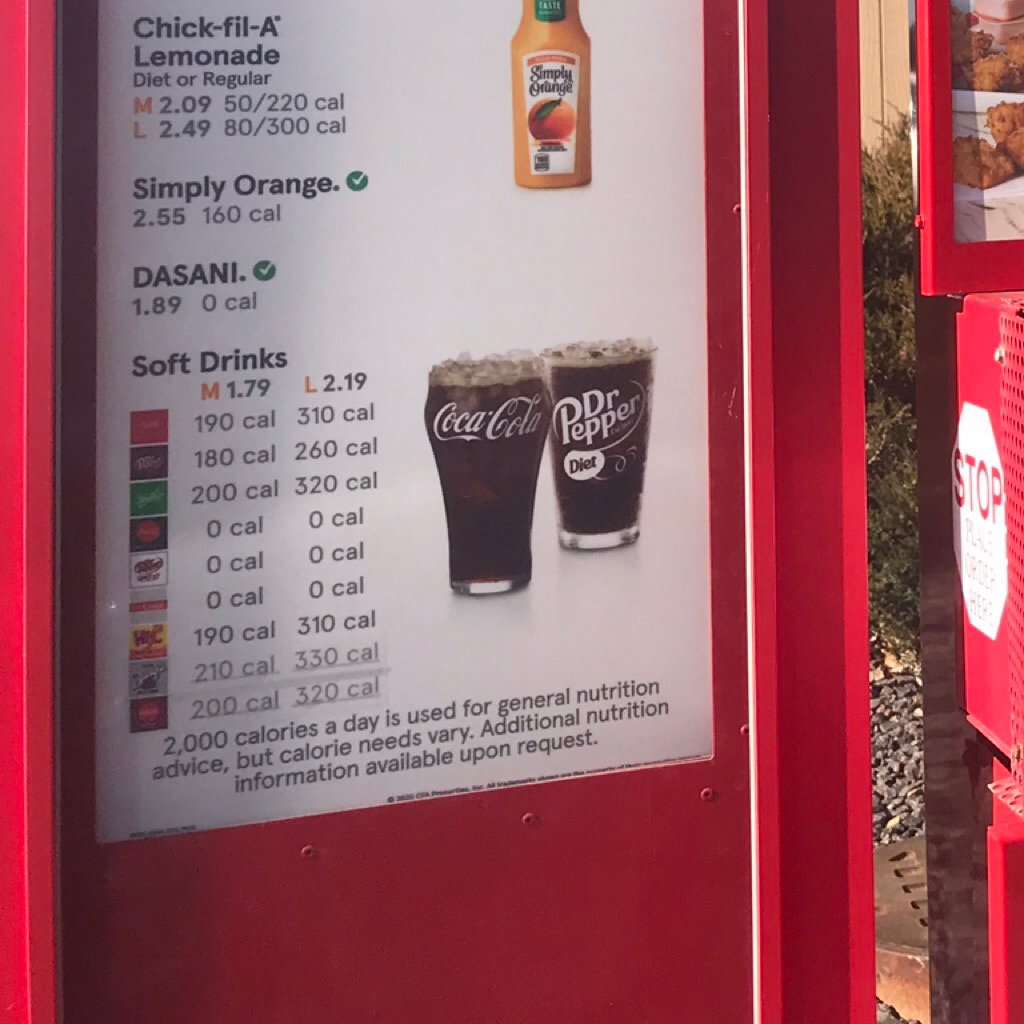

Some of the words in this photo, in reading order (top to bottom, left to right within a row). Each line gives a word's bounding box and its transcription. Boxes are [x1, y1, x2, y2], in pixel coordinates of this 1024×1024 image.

[135, 44, 279, 67] Lemonade
[132, 353, 190, 377] Soft
[200, 348, 287, 373] Drinks
[201, 382, 219, 400] M
[227, 379, 270, 399] 1.79
[305, 376, 317, 393] L
[323, 373, 367, 392] 2.19
[433, 392, 542, 442] Coca-Cola
[580, 389, 620, 416] Dr
[552, 394, 642, 444] Pepper
[567, 454, 598, 476] Diet
[955, 448, 1002, 524] STOP
[164, 731, 227, 756] 2,000
[235, 720, 319, 747] calories
[325, 721, 336, 735] a
[344, 714, 379, 733] day
[386, 709, 400, 727] is
[408, 701, 456, 724] used
[463, 700, 492, 717] for
[497, 689, 571, 717] general
[577, 680, 659, 704] nutrition
